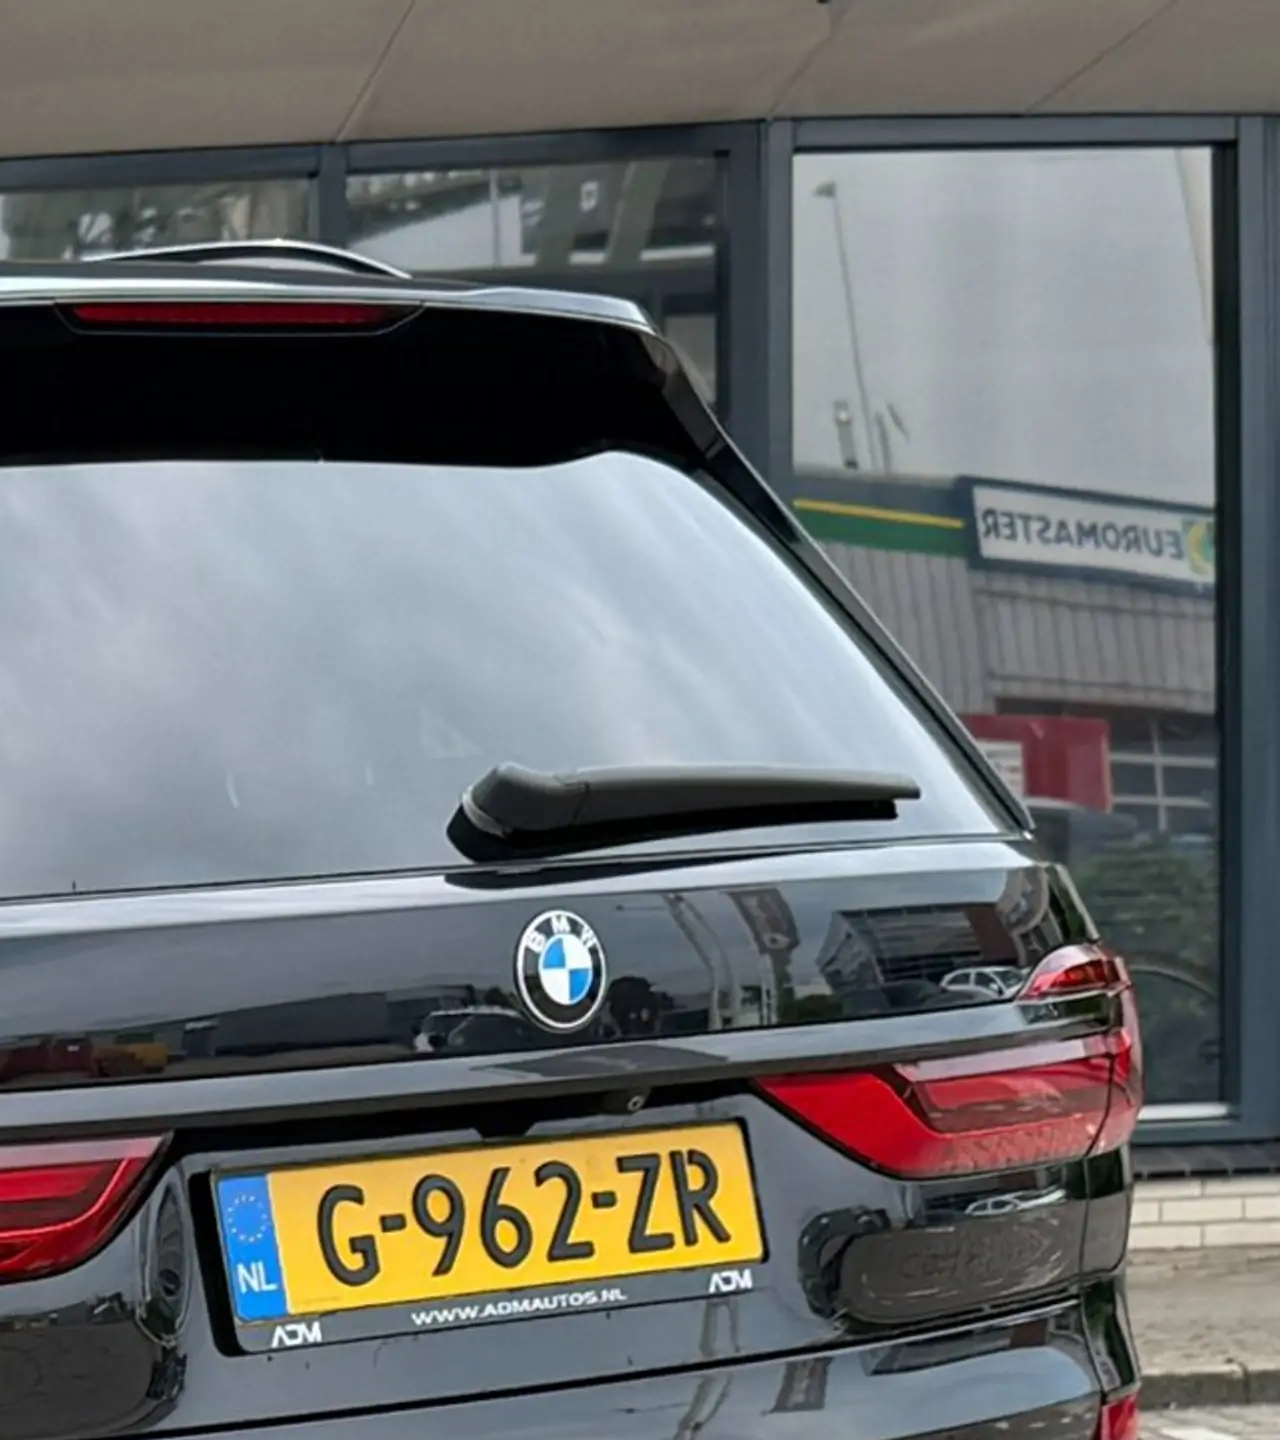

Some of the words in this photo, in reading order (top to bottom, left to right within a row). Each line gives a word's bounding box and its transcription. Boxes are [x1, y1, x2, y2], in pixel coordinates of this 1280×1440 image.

[525, 914, 597, 954] BMW
[317, 1148, 731, 1287] G-962-ZR
[237, 1261, 277, 1294] NL
[709, 1269, 752, 1293] ADM
[411, 1288, 627, 1326] WWW.ADMAUTOS.NL
[271, 1321, 321, 1348] ADM
